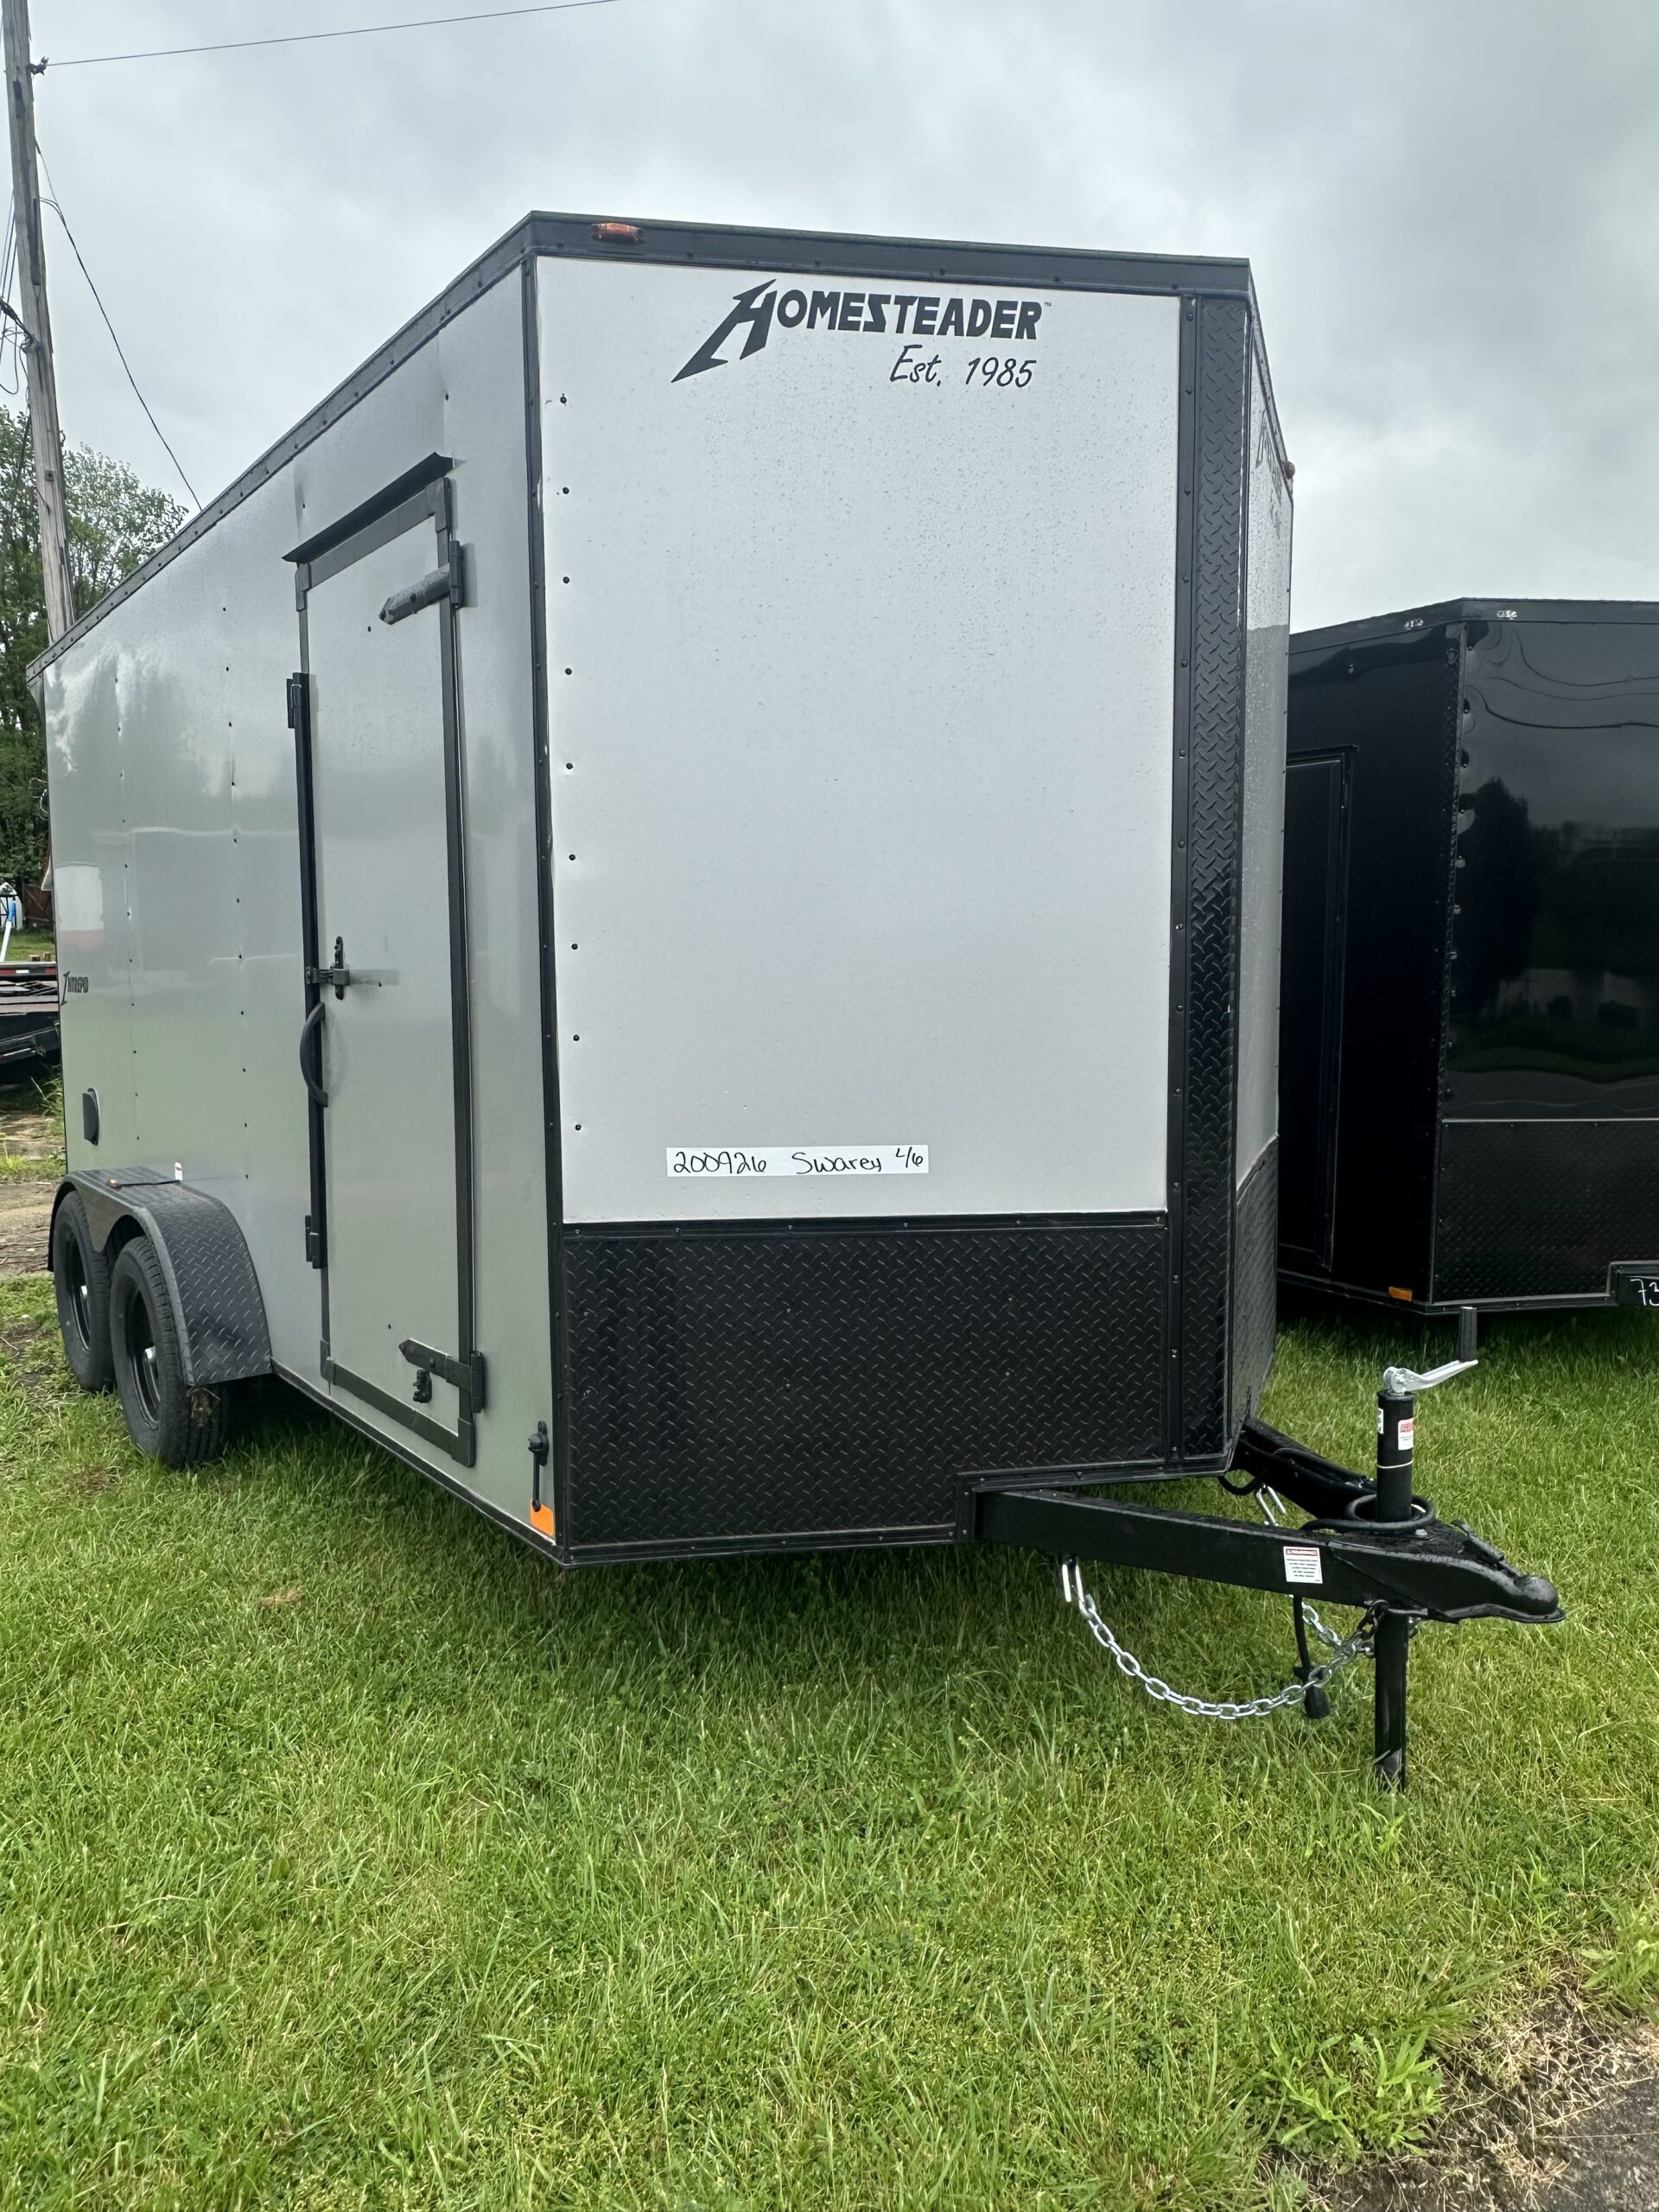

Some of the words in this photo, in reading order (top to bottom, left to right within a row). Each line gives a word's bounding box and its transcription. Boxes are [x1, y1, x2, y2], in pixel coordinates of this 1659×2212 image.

[671, 278, 1043, 383] HOMESTEADER
[889, 344, 942, 387] Est.
[965, 357, 1037, 388] 1985
[673, 1151, 767, 1174] 200926
